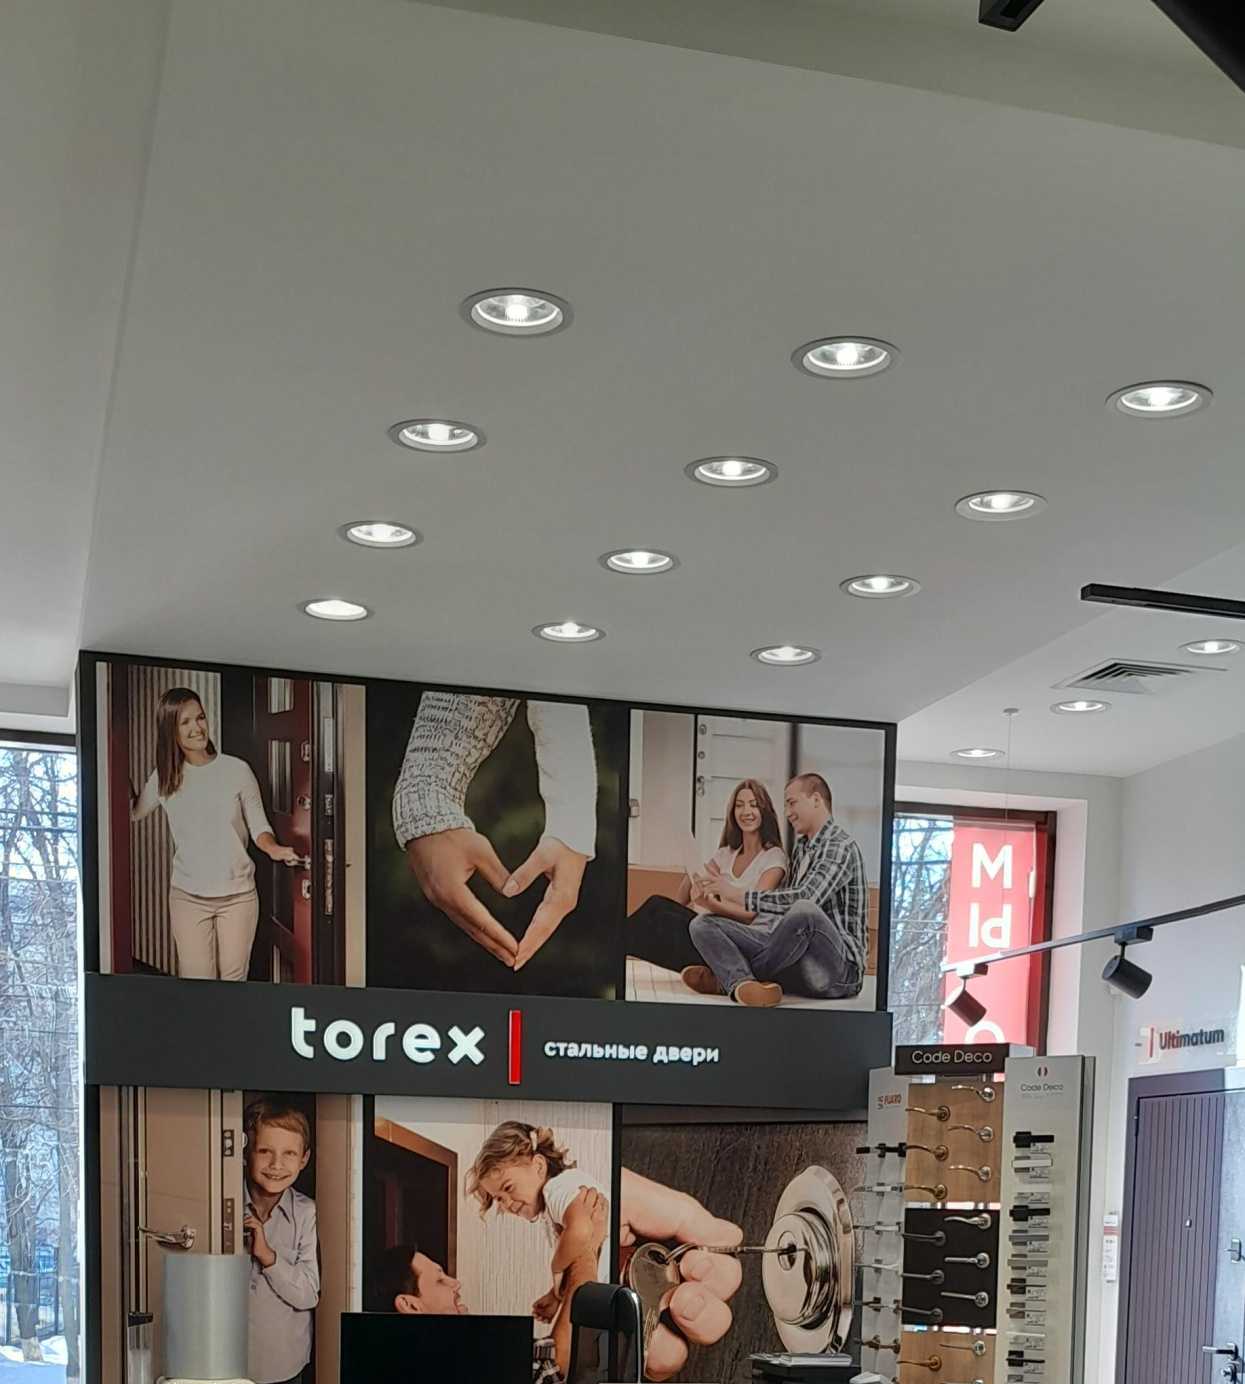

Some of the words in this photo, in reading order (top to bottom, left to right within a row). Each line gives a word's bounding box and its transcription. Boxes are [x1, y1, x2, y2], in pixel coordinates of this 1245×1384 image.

[291, 1006, 486, 1066] torex
[1159, 1028, 1225, 1051] Ultimatum
[544, 1041, 648, 1060] стальные
[652, 1045, 720, 1066] двери
[911, 1050, 951, 1064] Code
[954, 1049, 993, 1063] Deco
